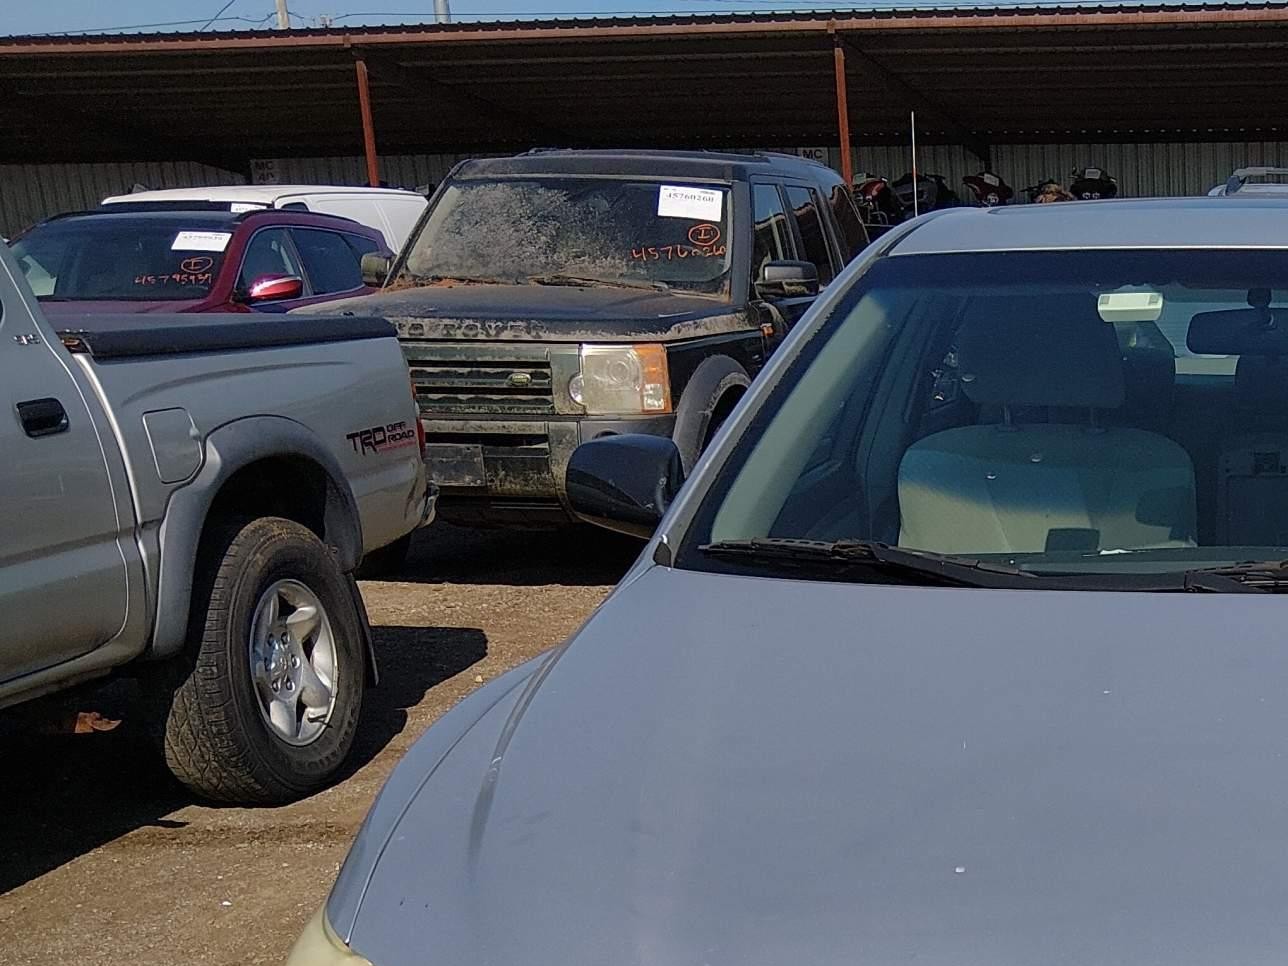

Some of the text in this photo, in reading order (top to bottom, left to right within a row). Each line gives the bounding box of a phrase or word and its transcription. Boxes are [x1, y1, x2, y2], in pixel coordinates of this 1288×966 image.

[801, 149, 823, 160] MC
[631, 244, 727, 262] 45760260
[386, 421, 406, 433] OFF
[346, 426, 387, 456] TRD
[388, 429, 415, 443] ROAD
